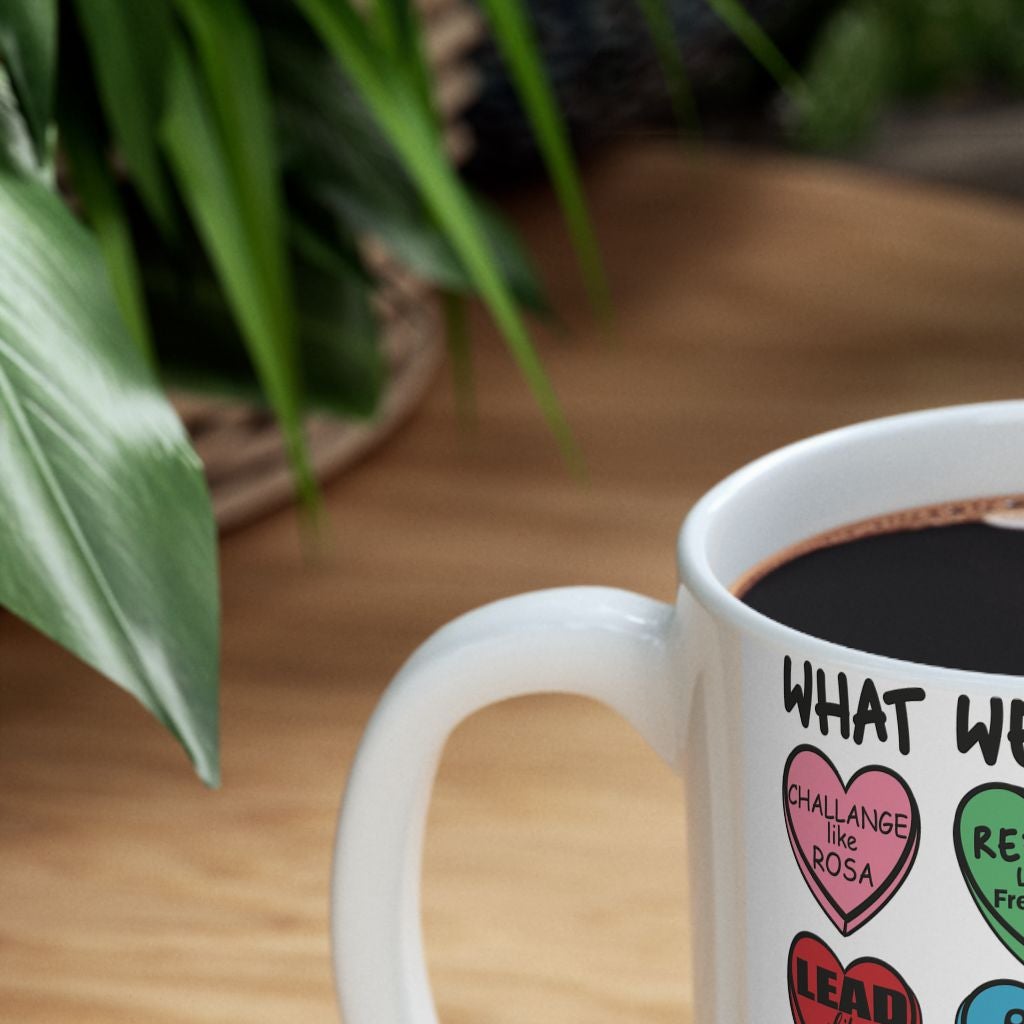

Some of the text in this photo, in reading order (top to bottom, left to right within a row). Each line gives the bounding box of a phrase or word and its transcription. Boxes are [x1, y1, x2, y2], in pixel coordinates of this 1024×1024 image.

[784, 655, 926, 755] WHAT
[788, 784, 908, 839] CHALLANGE
[827, 826, 858, 851] like
[812, 846, 874, 887] ROSA
